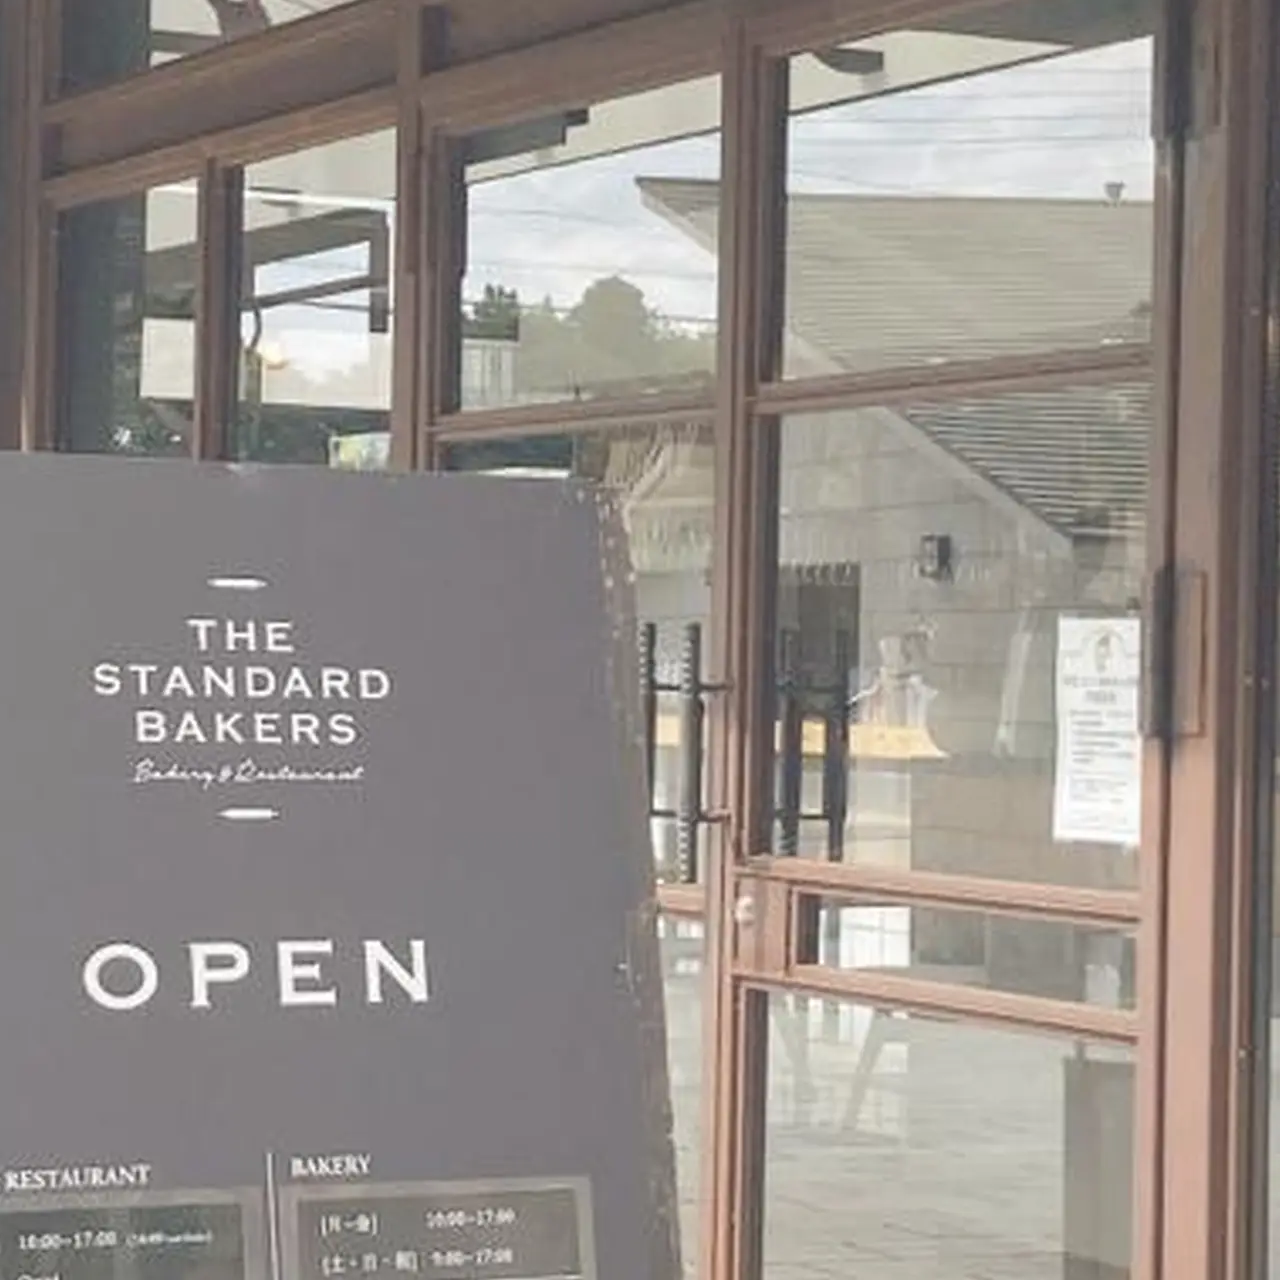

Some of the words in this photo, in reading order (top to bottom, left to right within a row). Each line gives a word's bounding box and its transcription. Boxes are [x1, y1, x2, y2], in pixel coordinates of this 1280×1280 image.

[187, 619, 294, 653] THE
[93, 663, 390, 700] STANDARD
[135, 710, 357, 745] BAKERS
[82, 938, 429, 1010] OPEN
[4, 1163, 152, 1190] RESTAURANT
[290, 1154, 371, 1178] BAKERY
